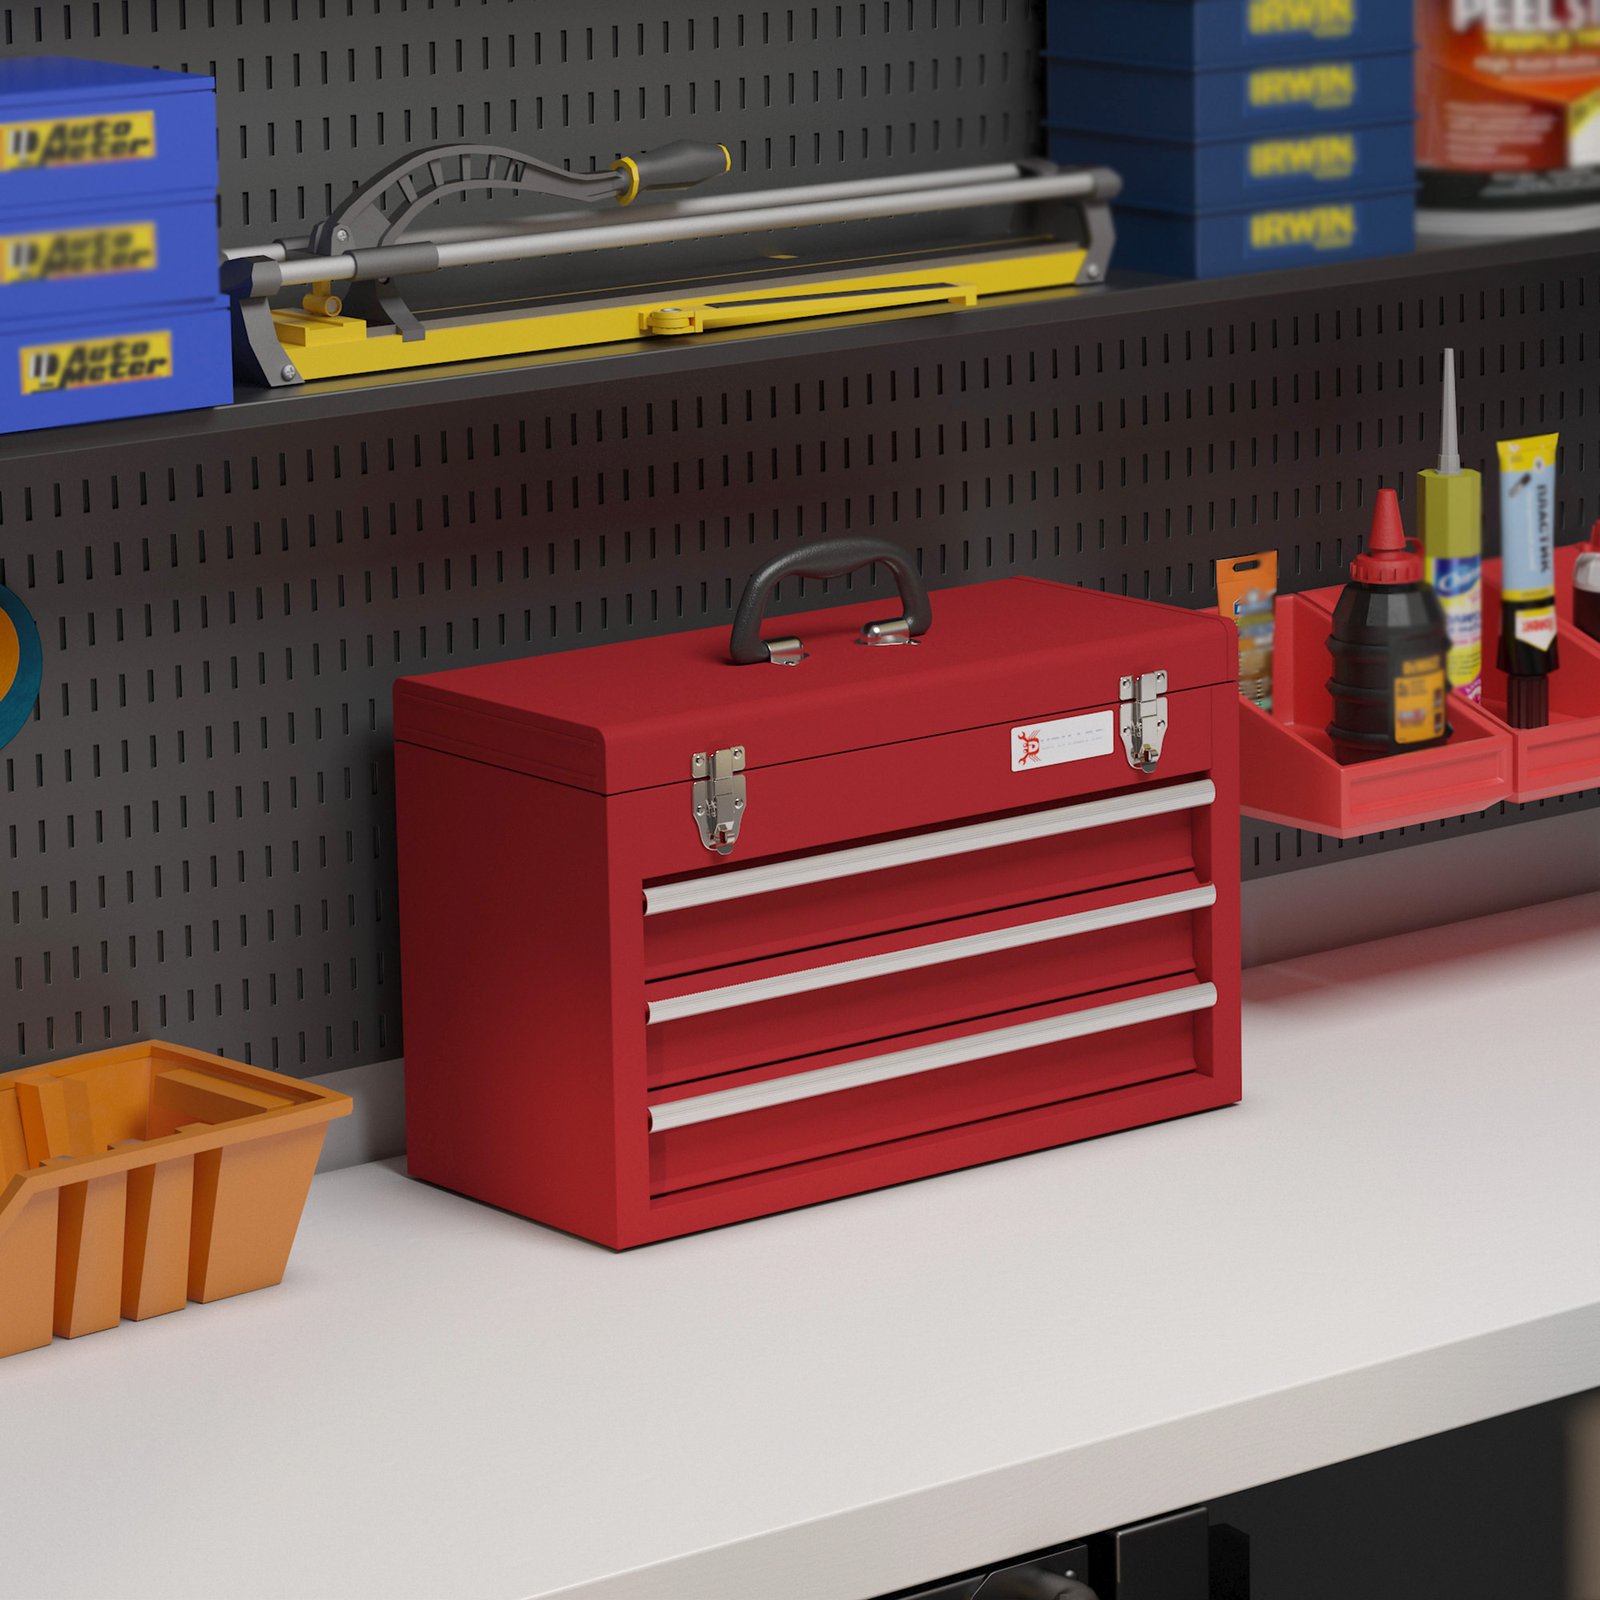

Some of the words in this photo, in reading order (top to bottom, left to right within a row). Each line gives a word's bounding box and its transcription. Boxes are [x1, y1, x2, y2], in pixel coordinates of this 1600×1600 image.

[1251, 205, 1355, 248] IRWIN
[65, 341, 150, 366] Auto
[58, 357, 167, 389] Meter
